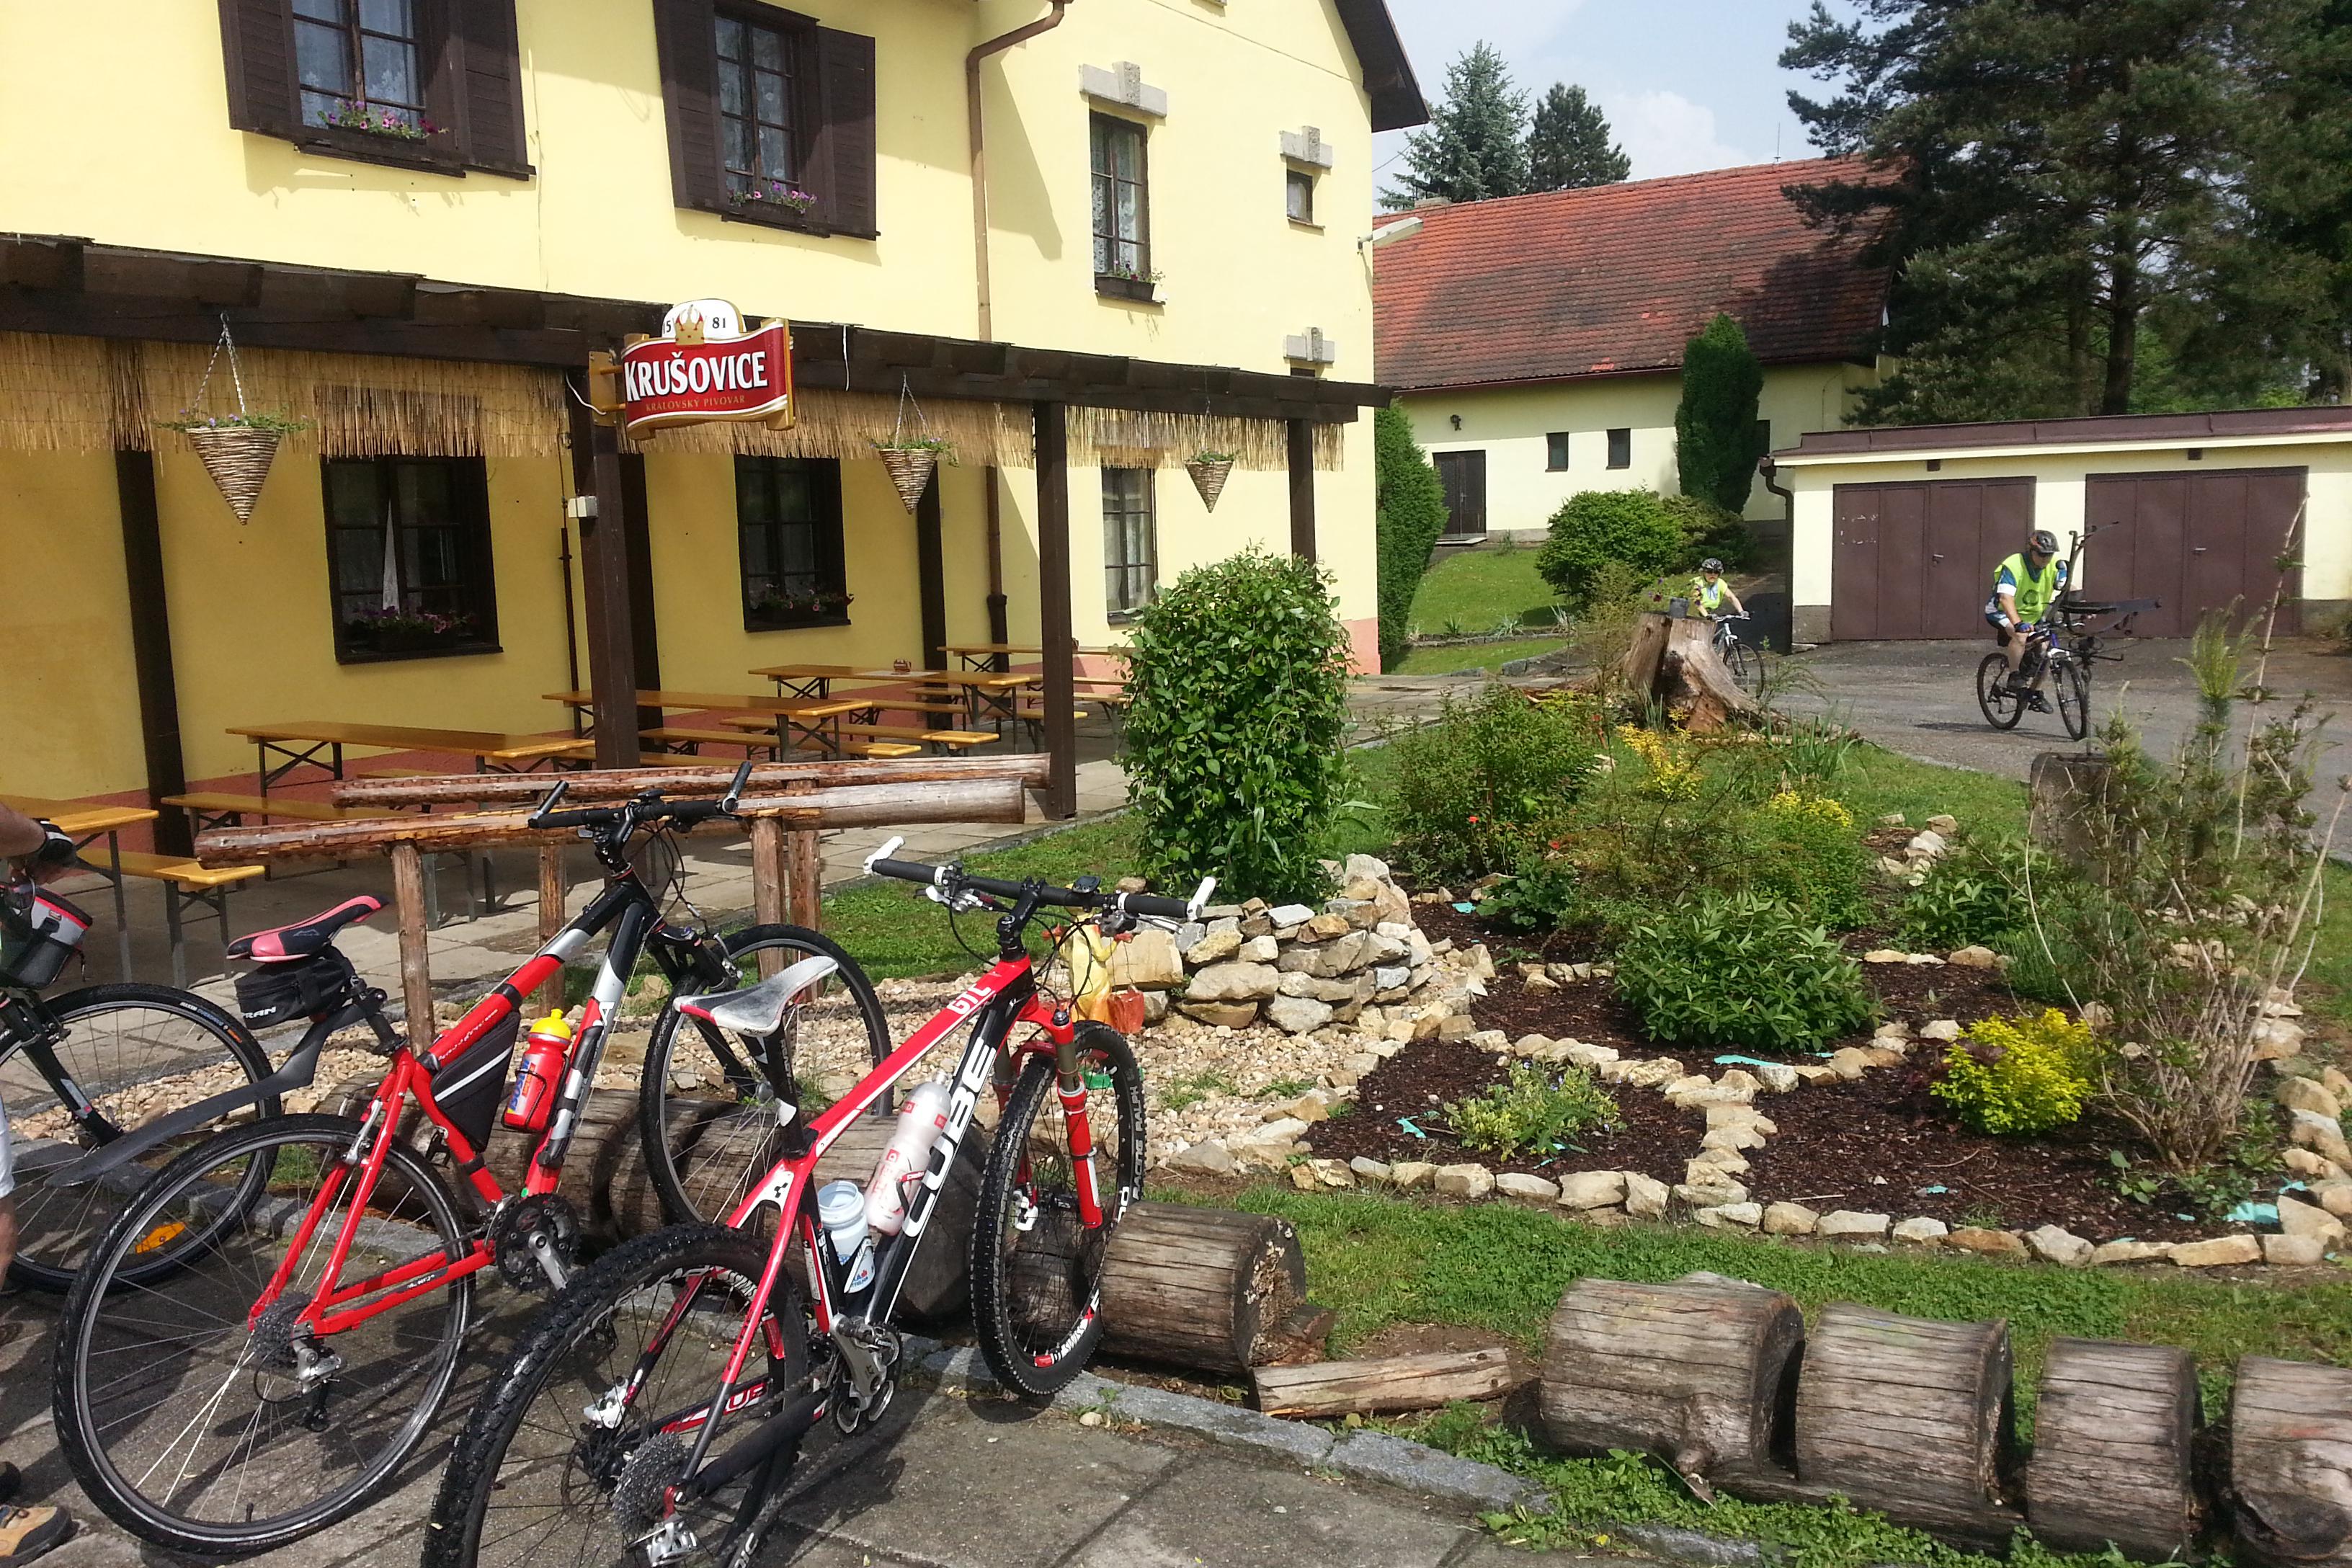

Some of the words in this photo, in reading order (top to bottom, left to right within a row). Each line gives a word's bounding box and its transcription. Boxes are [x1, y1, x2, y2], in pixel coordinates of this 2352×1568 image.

[663, 320, 672, 334] 15
[712, 316, 726, 329] 81
[624, 350, 768, 402] KRUŠOVICE
[704, 395, 745, 406] PIVOVAR
[1129, 1085, 1144, 1132] RALPH
[902, 1035, 996, 1237] CUBE
[1132, 1139, 1144, 1194] RACING
